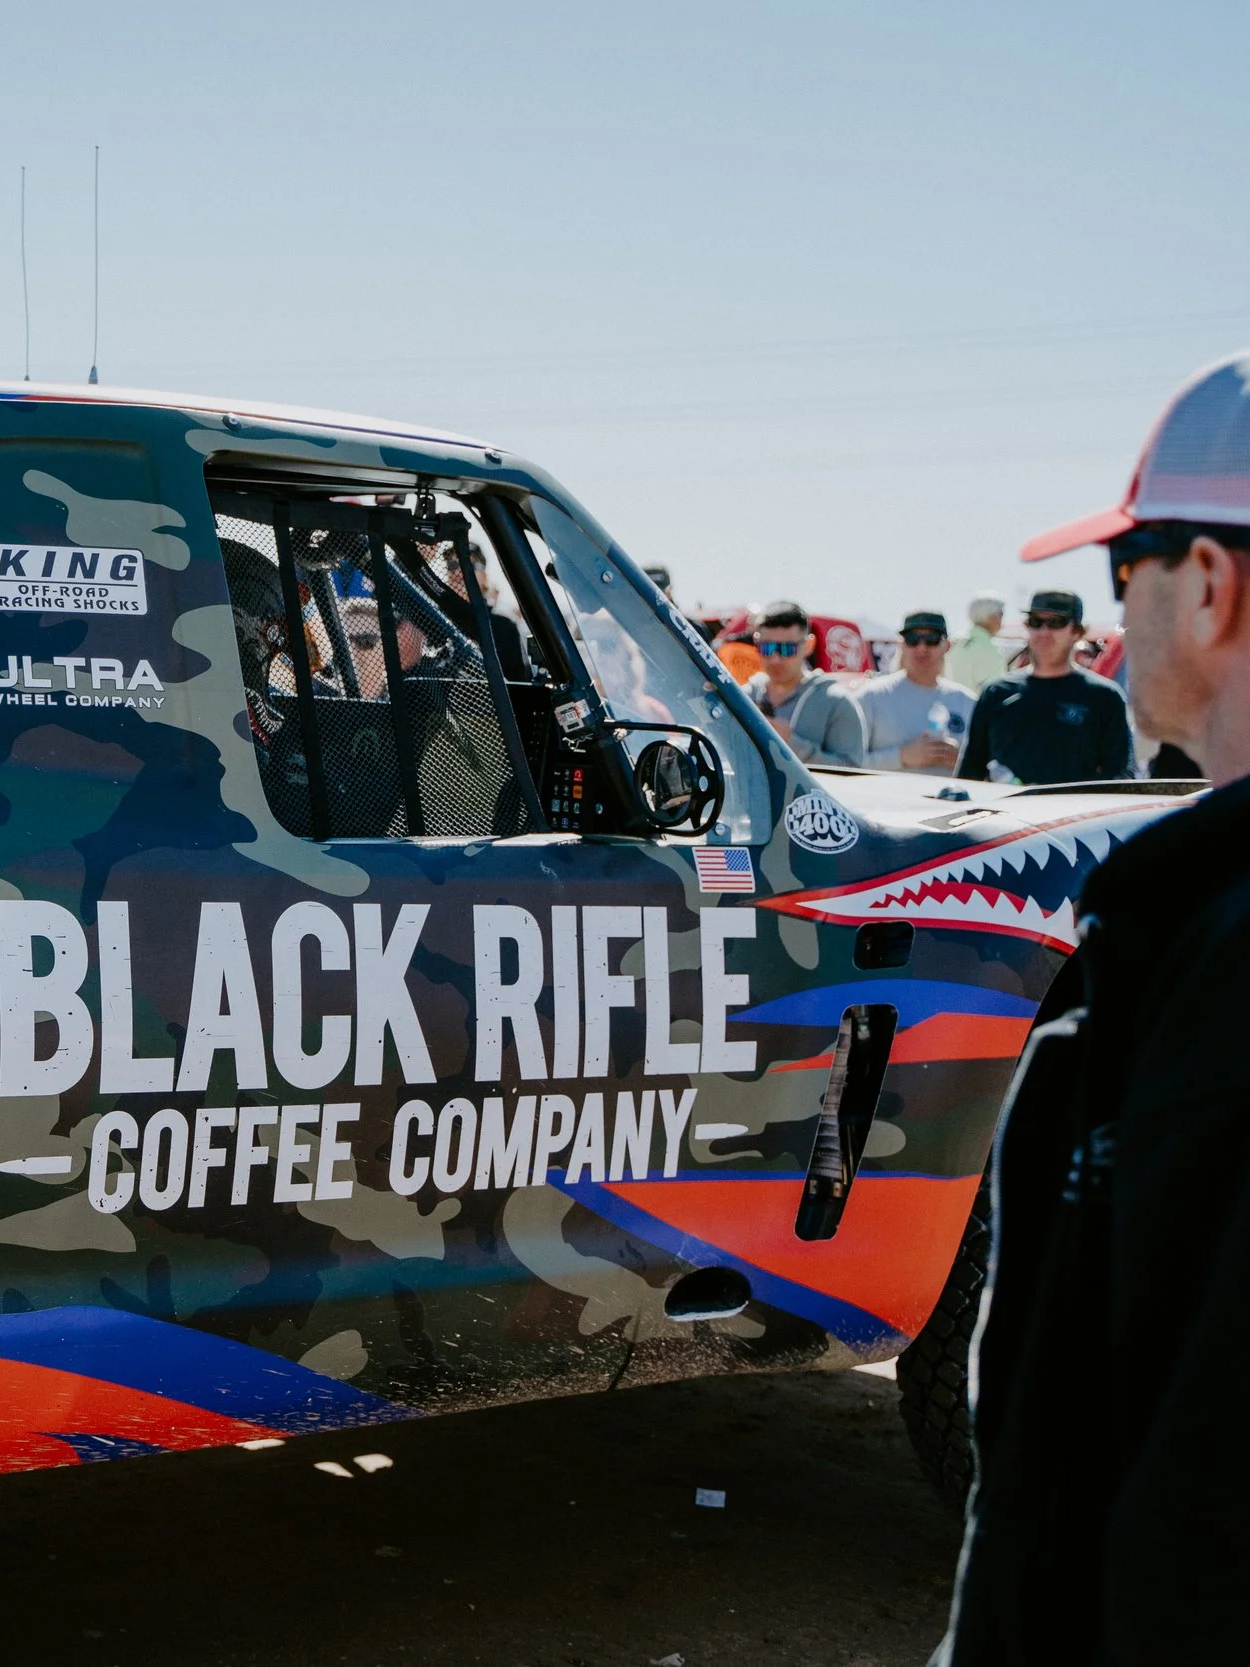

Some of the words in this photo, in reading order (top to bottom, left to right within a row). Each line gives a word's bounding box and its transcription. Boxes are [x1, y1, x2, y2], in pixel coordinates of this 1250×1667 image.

[18, 585, 109, 597] OFF-ROAD
[0, 597, 65, 608] RACING
[74, 599, 140, 611] SHOCKS
[65, 695, 165, 709] COMPANY
[799, 813, 848, 838] 400
[474, 904, 757, 1082] RIFLE
[88, 1102, 360, 1214] COFFEE
[389, 1089, 699, 1195] COMPANY
